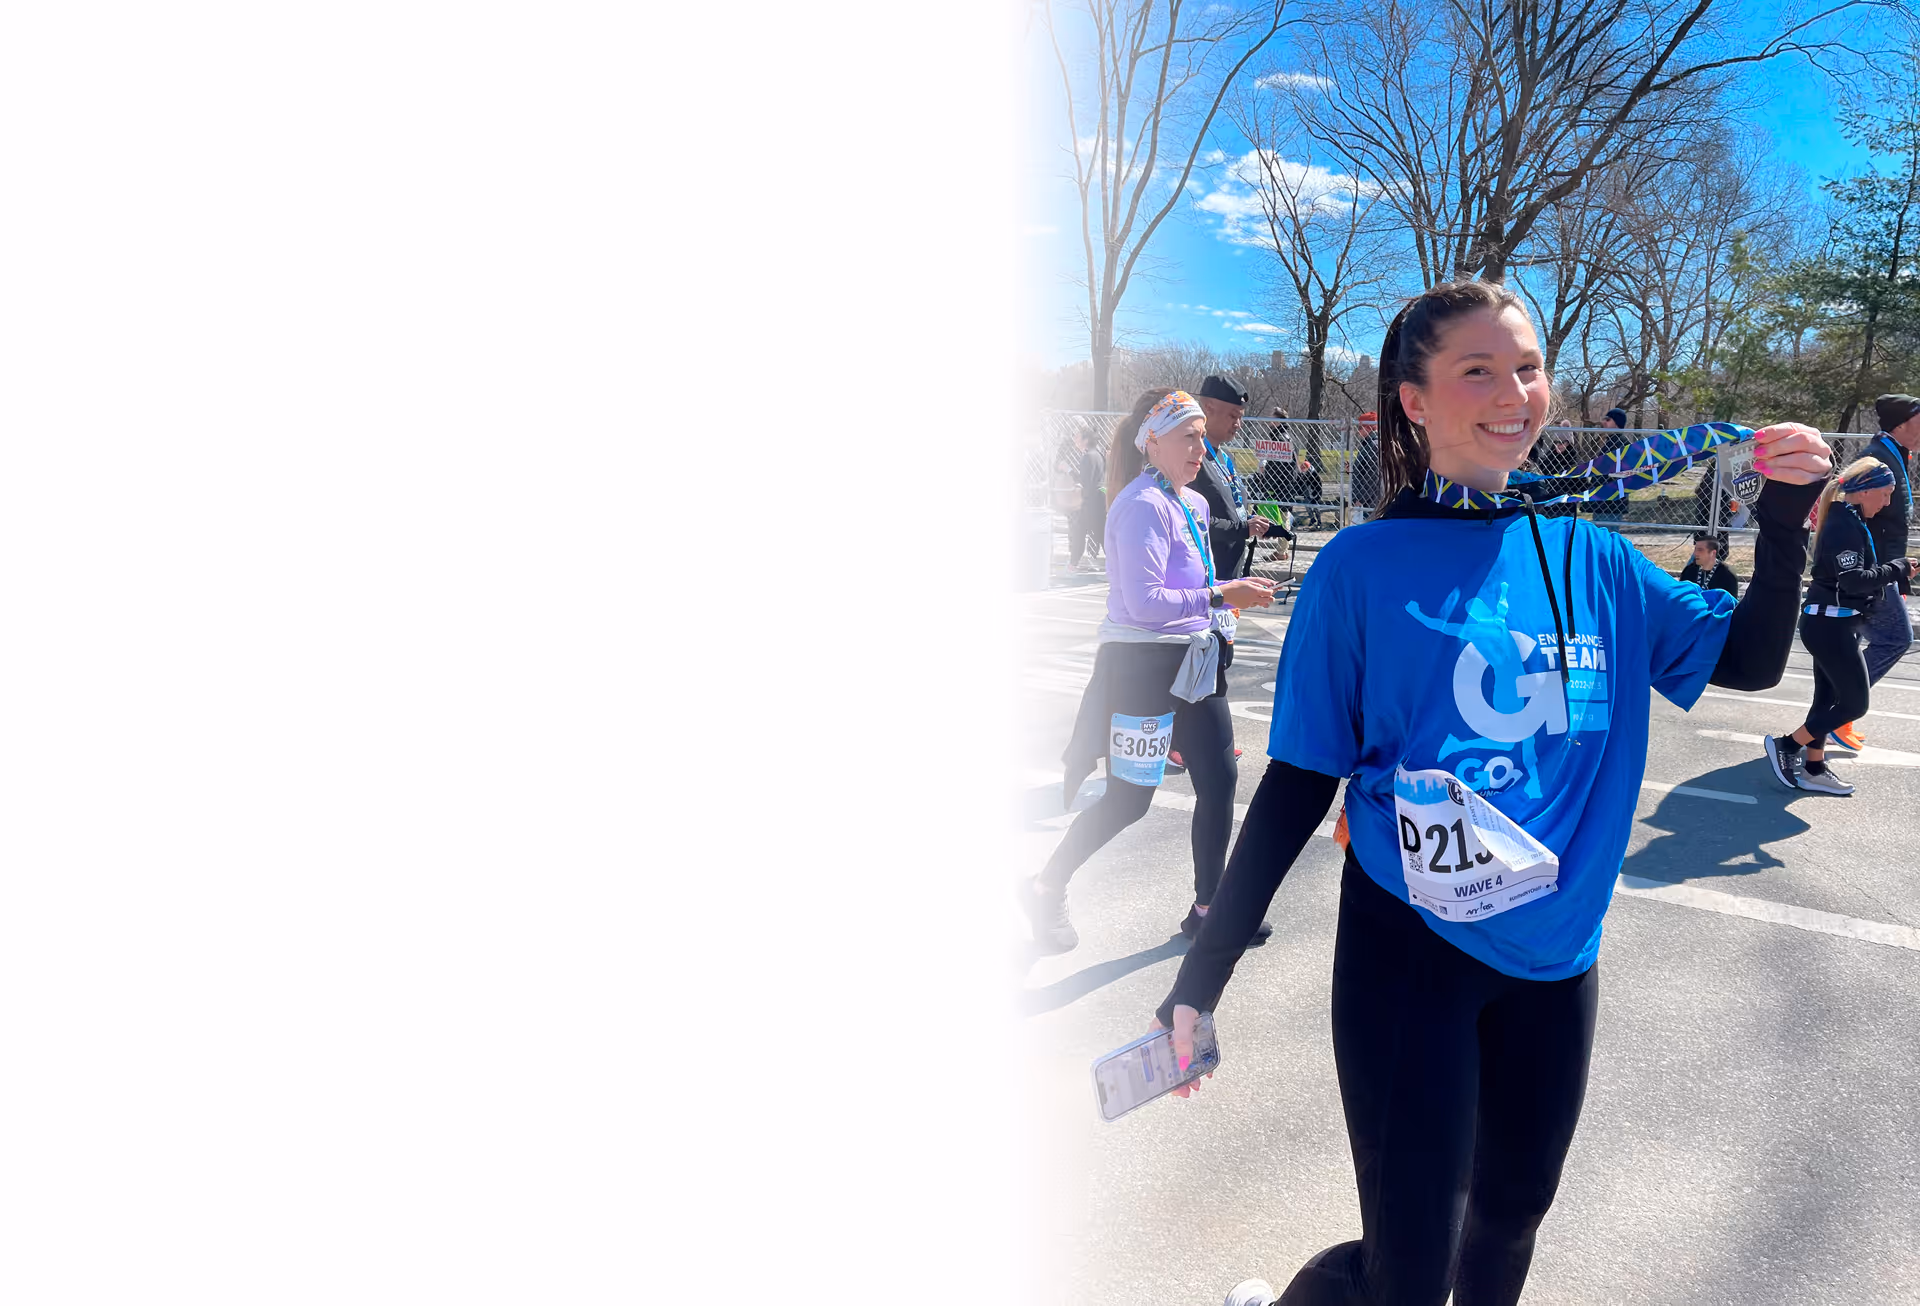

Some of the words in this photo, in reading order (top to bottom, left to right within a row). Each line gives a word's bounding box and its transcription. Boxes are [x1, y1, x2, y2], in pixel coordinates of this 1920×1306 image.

[1255, 440, 1292, 452] NATIONAL
[1738, 477, 1757, 491] NYC
[1740, 486, 1756, 496] HALF
[1840, 555, 1856, 563] NYC
[1540, 645, 1607, 671] TEAM
[1113, 732, 1124, 748] C
[1399, 813, 1421, 853] D
[1454, 879, 1493, 898] WAVE
[1495, 875, 1503, 886] 4
